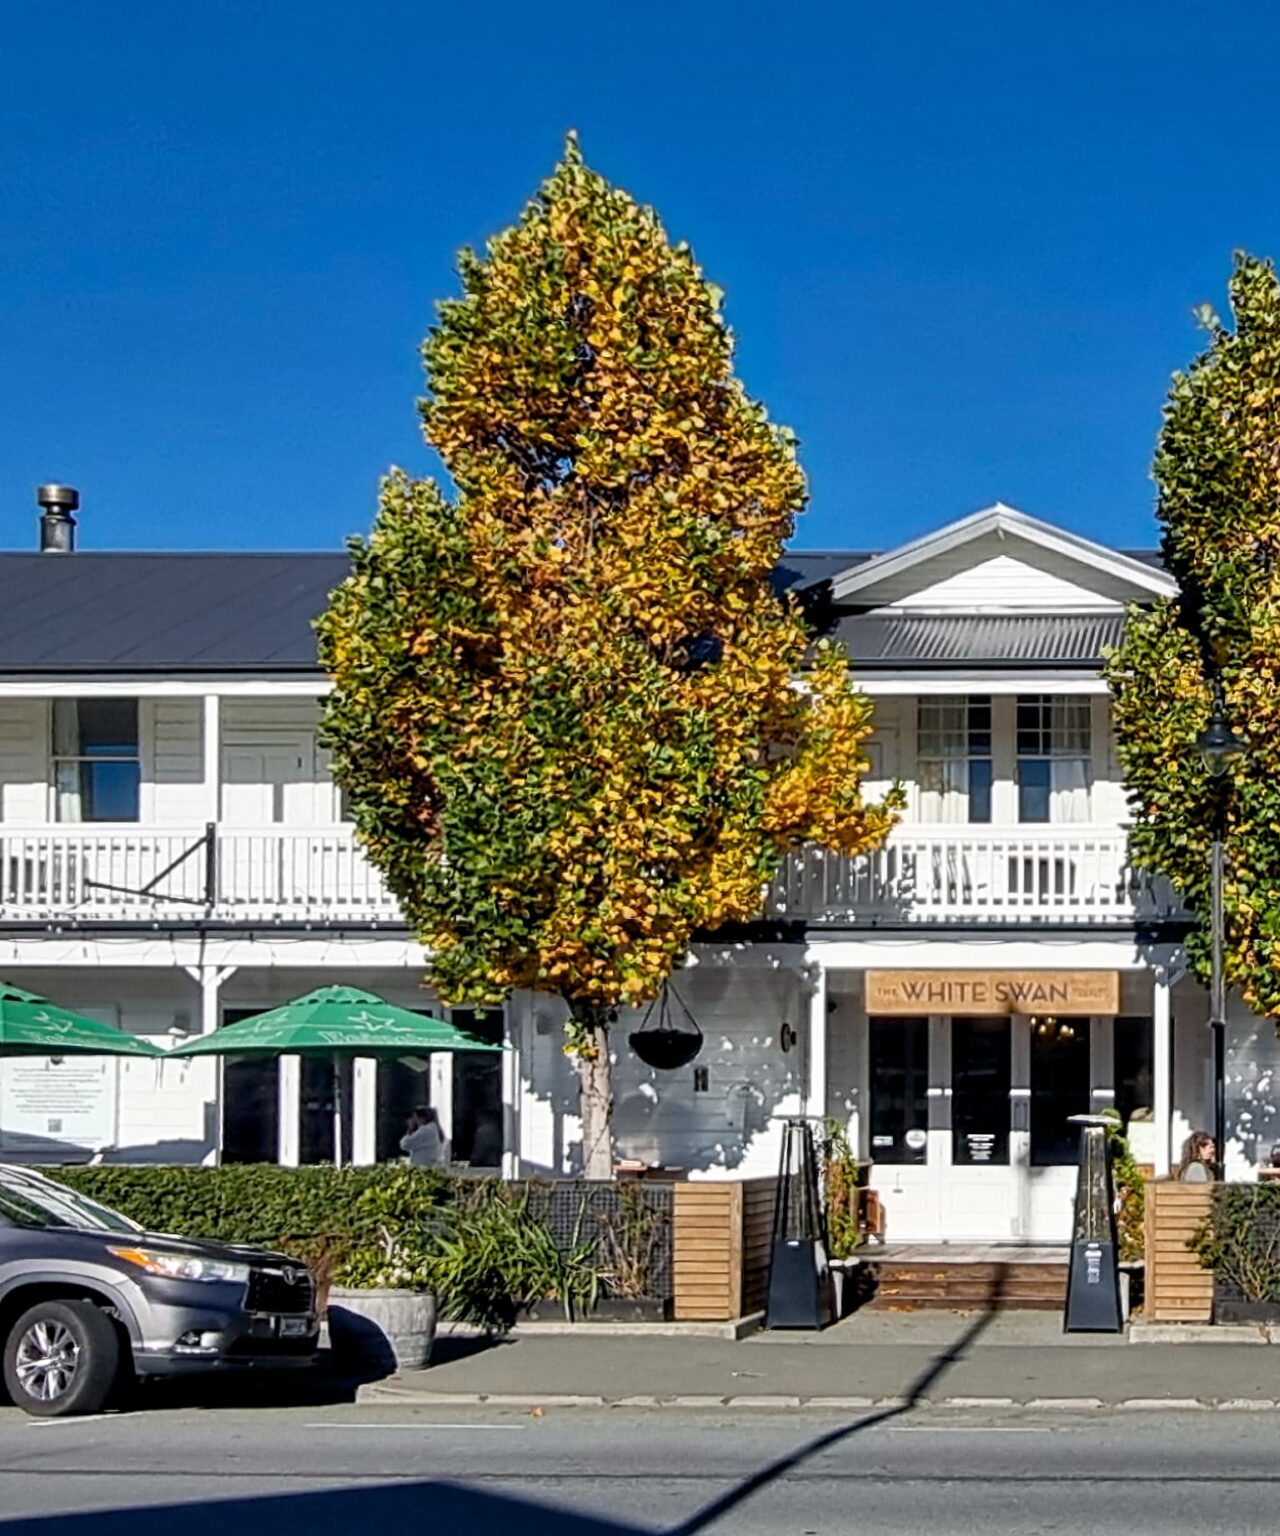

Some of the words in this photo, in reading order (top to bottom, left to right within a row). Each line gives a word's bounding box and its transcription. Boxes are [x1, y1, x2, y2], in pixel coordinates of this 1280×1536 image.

[877, 987, 899, 998] THE
[901, 981, 987, 1002] WHITE
[995, 981, 1068, 1002] SWAN
